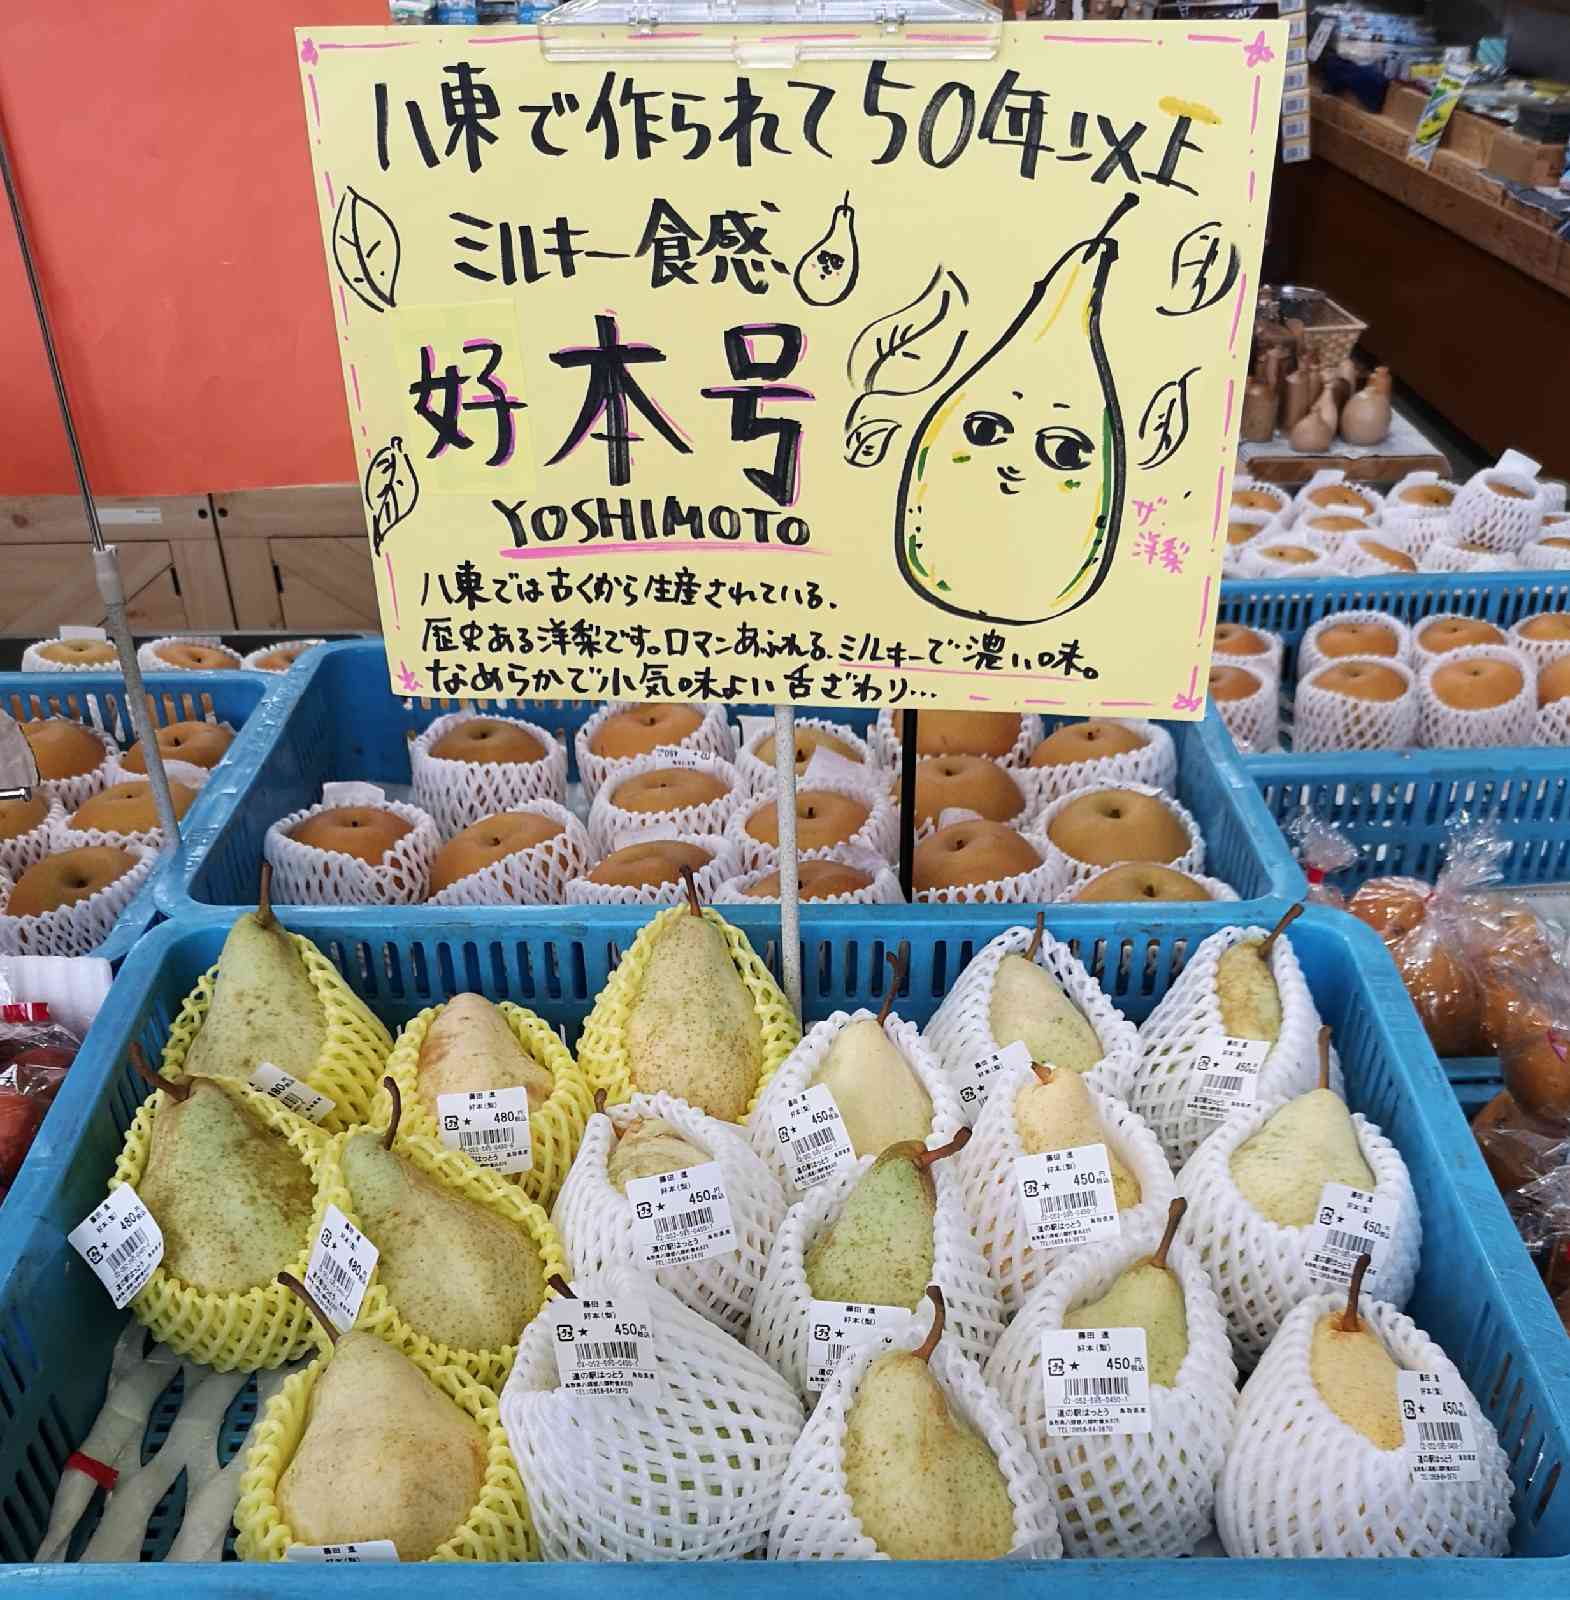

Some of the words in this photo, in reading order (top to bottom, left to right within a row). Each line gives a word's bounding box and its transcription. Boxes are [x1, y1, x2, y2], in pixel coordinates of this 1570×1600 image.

[375, 60, 1208, 197] 八東で作られて50年以上
[449, 197, 791, 295] ミルキー食感
[409, 310, 817, 507] 好本号
[492, 495, 812, 548] YOSHIMOTO
[1074, 1172, 1095, 1186] 450
[689, 1190, 711, 1205] 450
[614, 1323, 637, 1336] 450
[1106, 1357, 1130, 1370] 450
